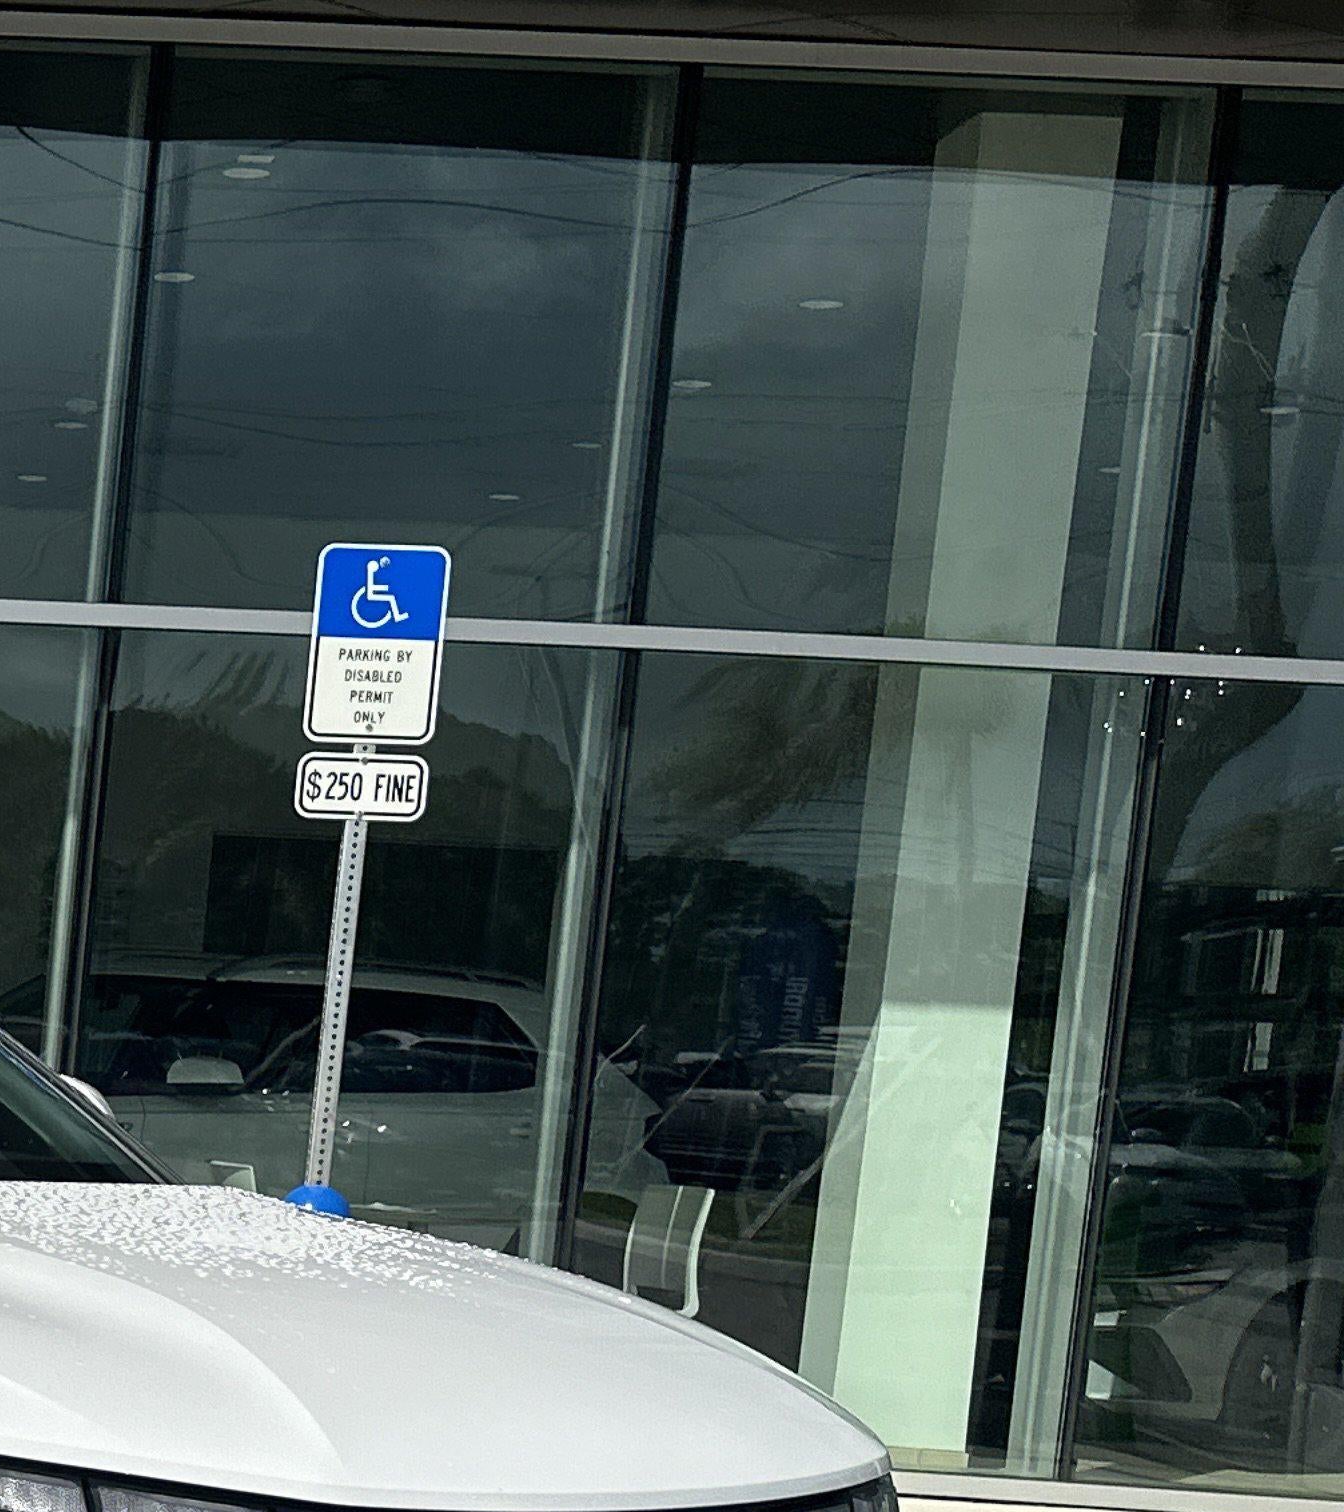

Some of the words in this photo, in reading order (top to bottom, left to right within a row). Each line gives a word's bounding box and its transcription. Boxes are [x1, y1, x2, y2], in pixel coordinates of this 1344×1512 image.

[338, 648, 391, 662] PARKING
[396, 650, 413, 663] BY
[344, 668, 403, 684] DISABLED
[349, 690, 394, 704] PERMIT
[353, 710, 386, 724] ONLY
[306, 769, 364, 802] $250
[373, 773, 417, 803] FINE
